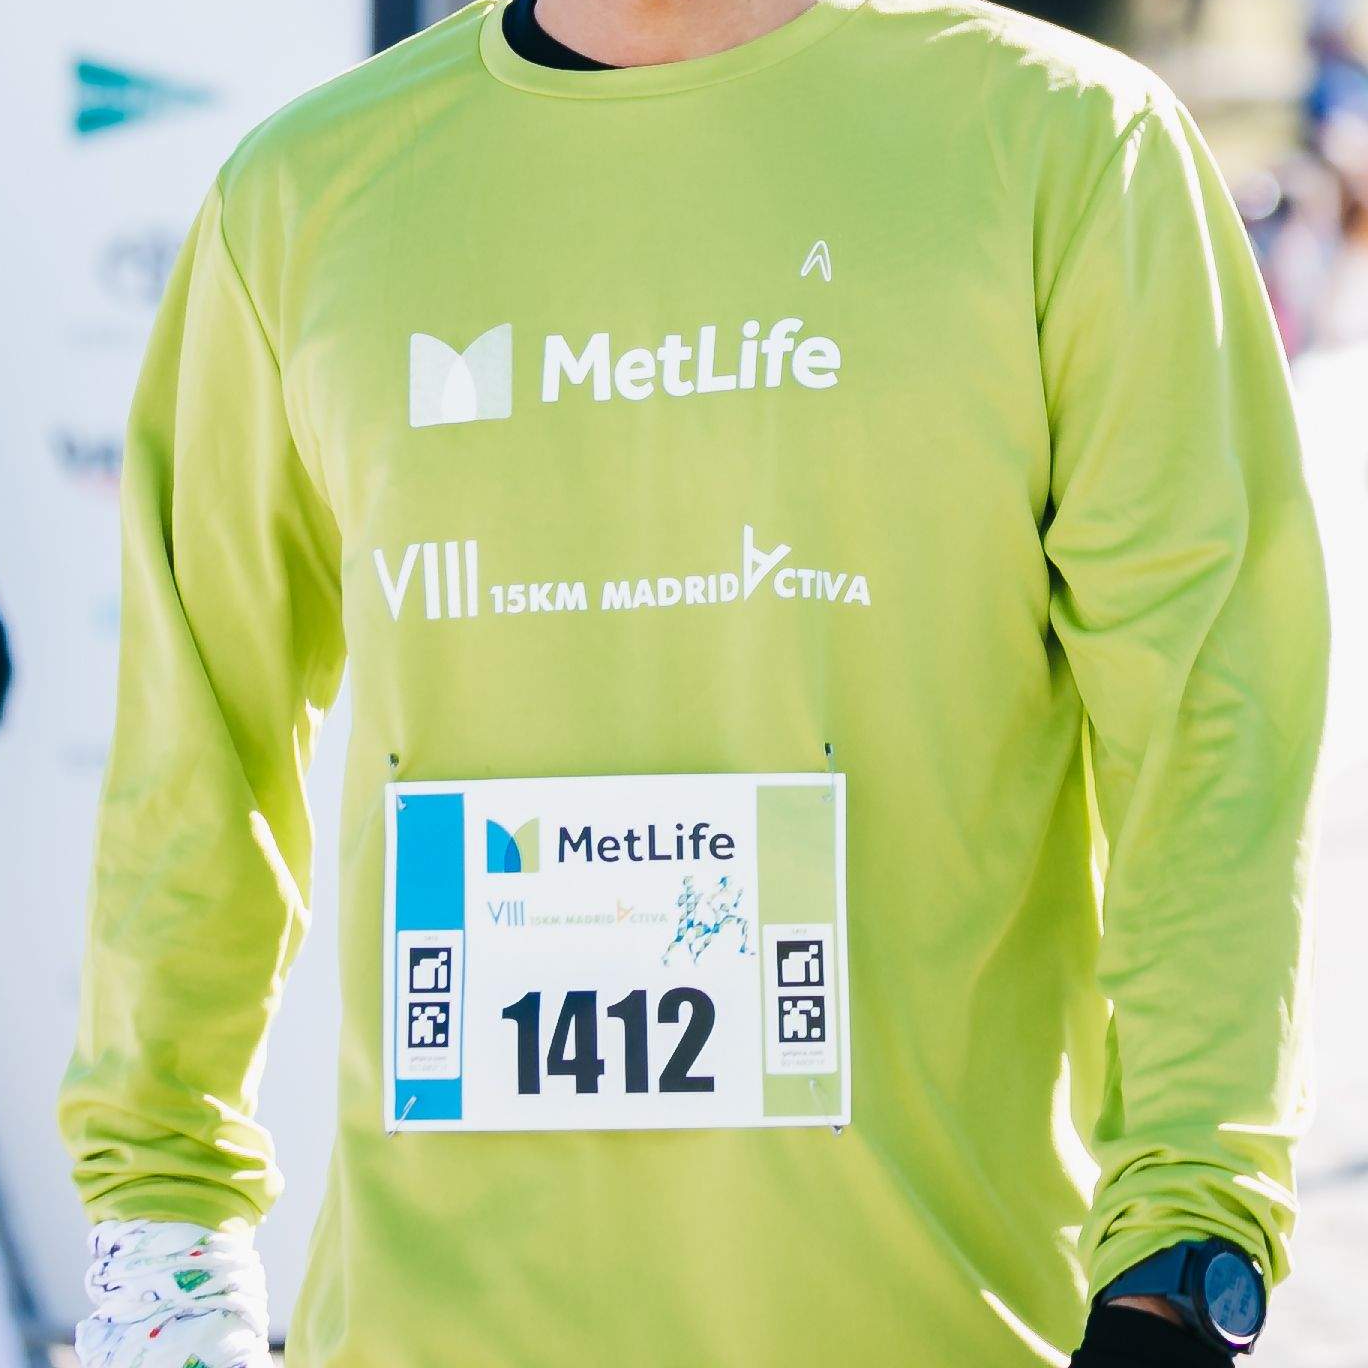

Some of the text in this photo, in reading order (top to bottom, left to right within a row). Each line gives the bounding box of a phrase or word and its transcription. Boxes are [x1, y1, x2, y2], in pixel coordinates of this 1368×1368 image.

[542, 317, 841, 402] MetLife
[373, 540, 478, 622] VIII
[489, 581, 588, 614] 15KM
[558, 822, 735, 863] MetLife
[487, 901, 525, 926] VIII
[502, 987, 715, 1094] 1412
